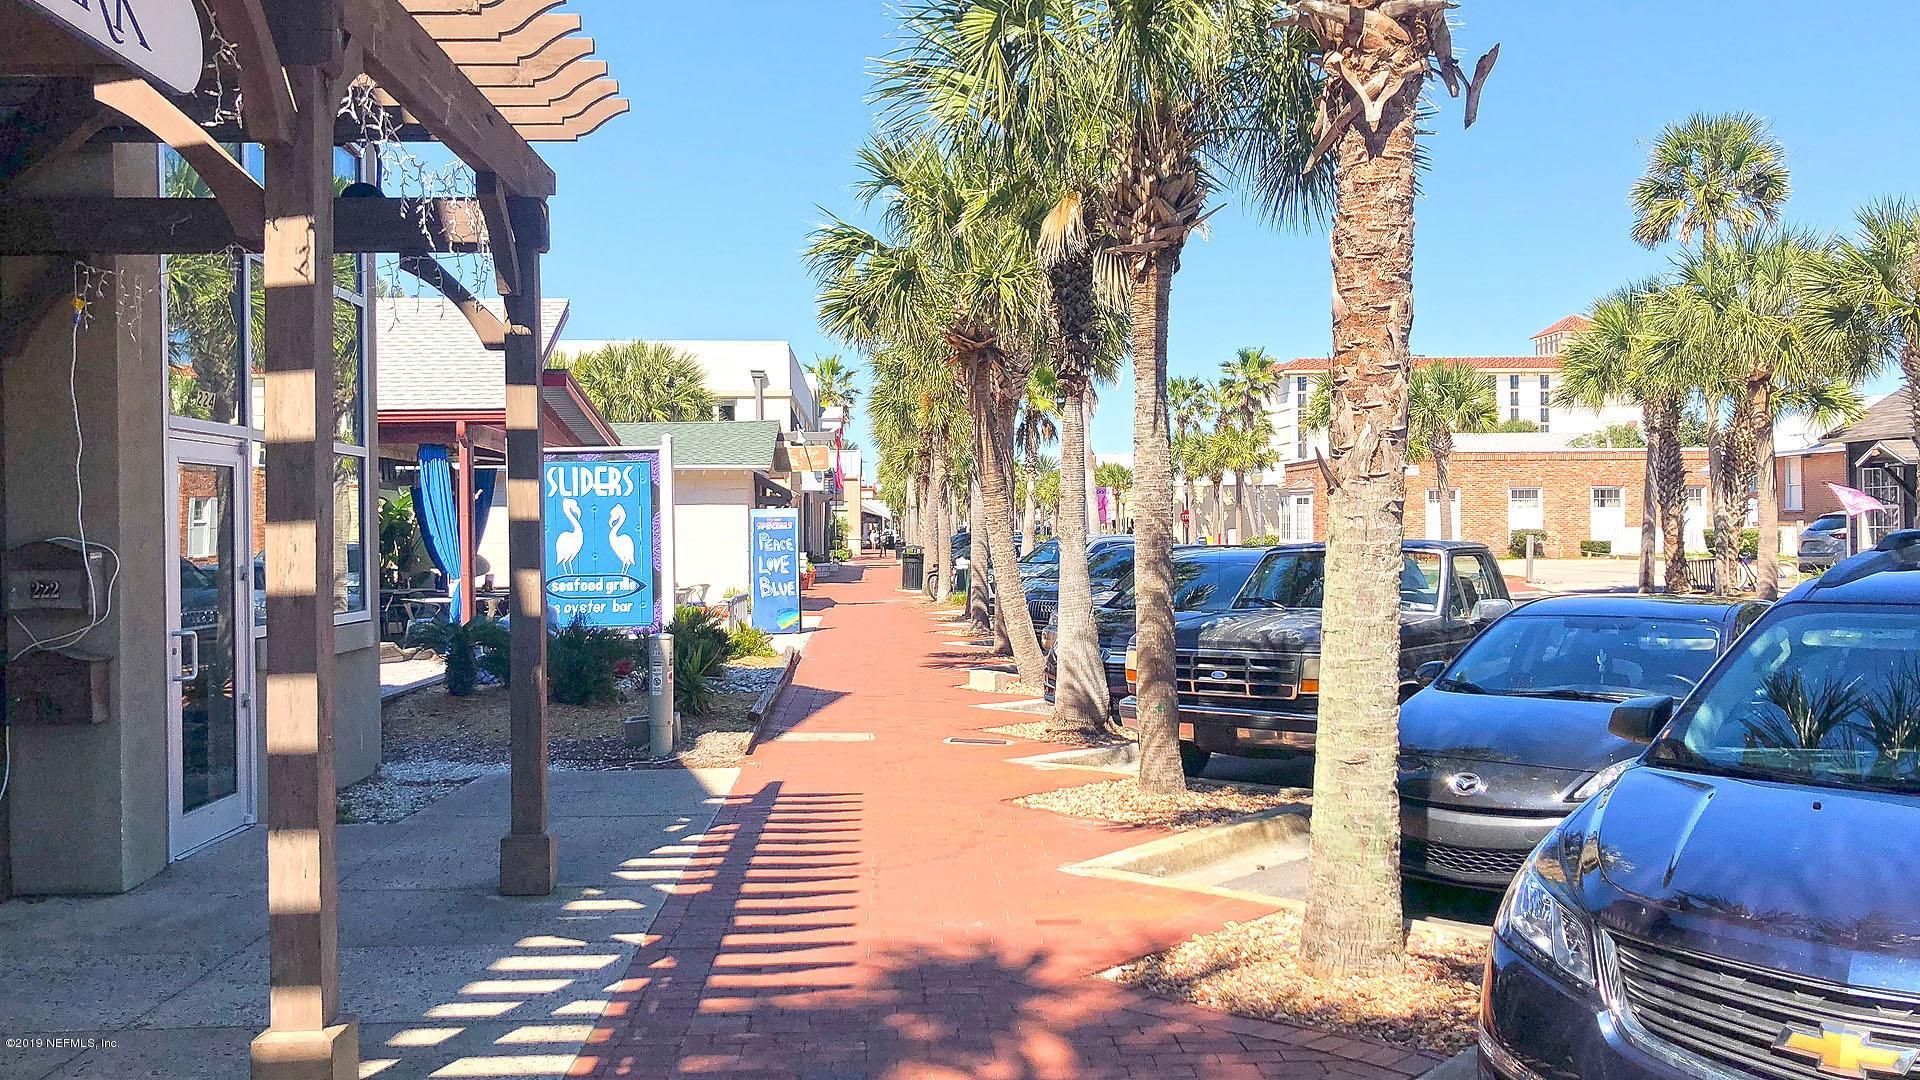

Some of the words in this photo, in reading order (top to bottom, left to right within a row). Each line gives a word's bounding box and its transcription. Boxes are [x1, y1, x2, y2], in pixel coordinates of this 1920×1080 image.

[197, 391, 215, 409] 224
[546, 465, 635, 497] SLIDERS
[758, 532, 795, 551] PEACE
[758, 554, 791, 575] LOVE
[31, 580, 60, 599] 222
[551, 577, 604, 593] seafood
[605, 576, 638, 595] grille
[759, 575, 797, 598] BLUE
[563, 599, 607, 617] oyster
[611, 599, 634, 614] bar
